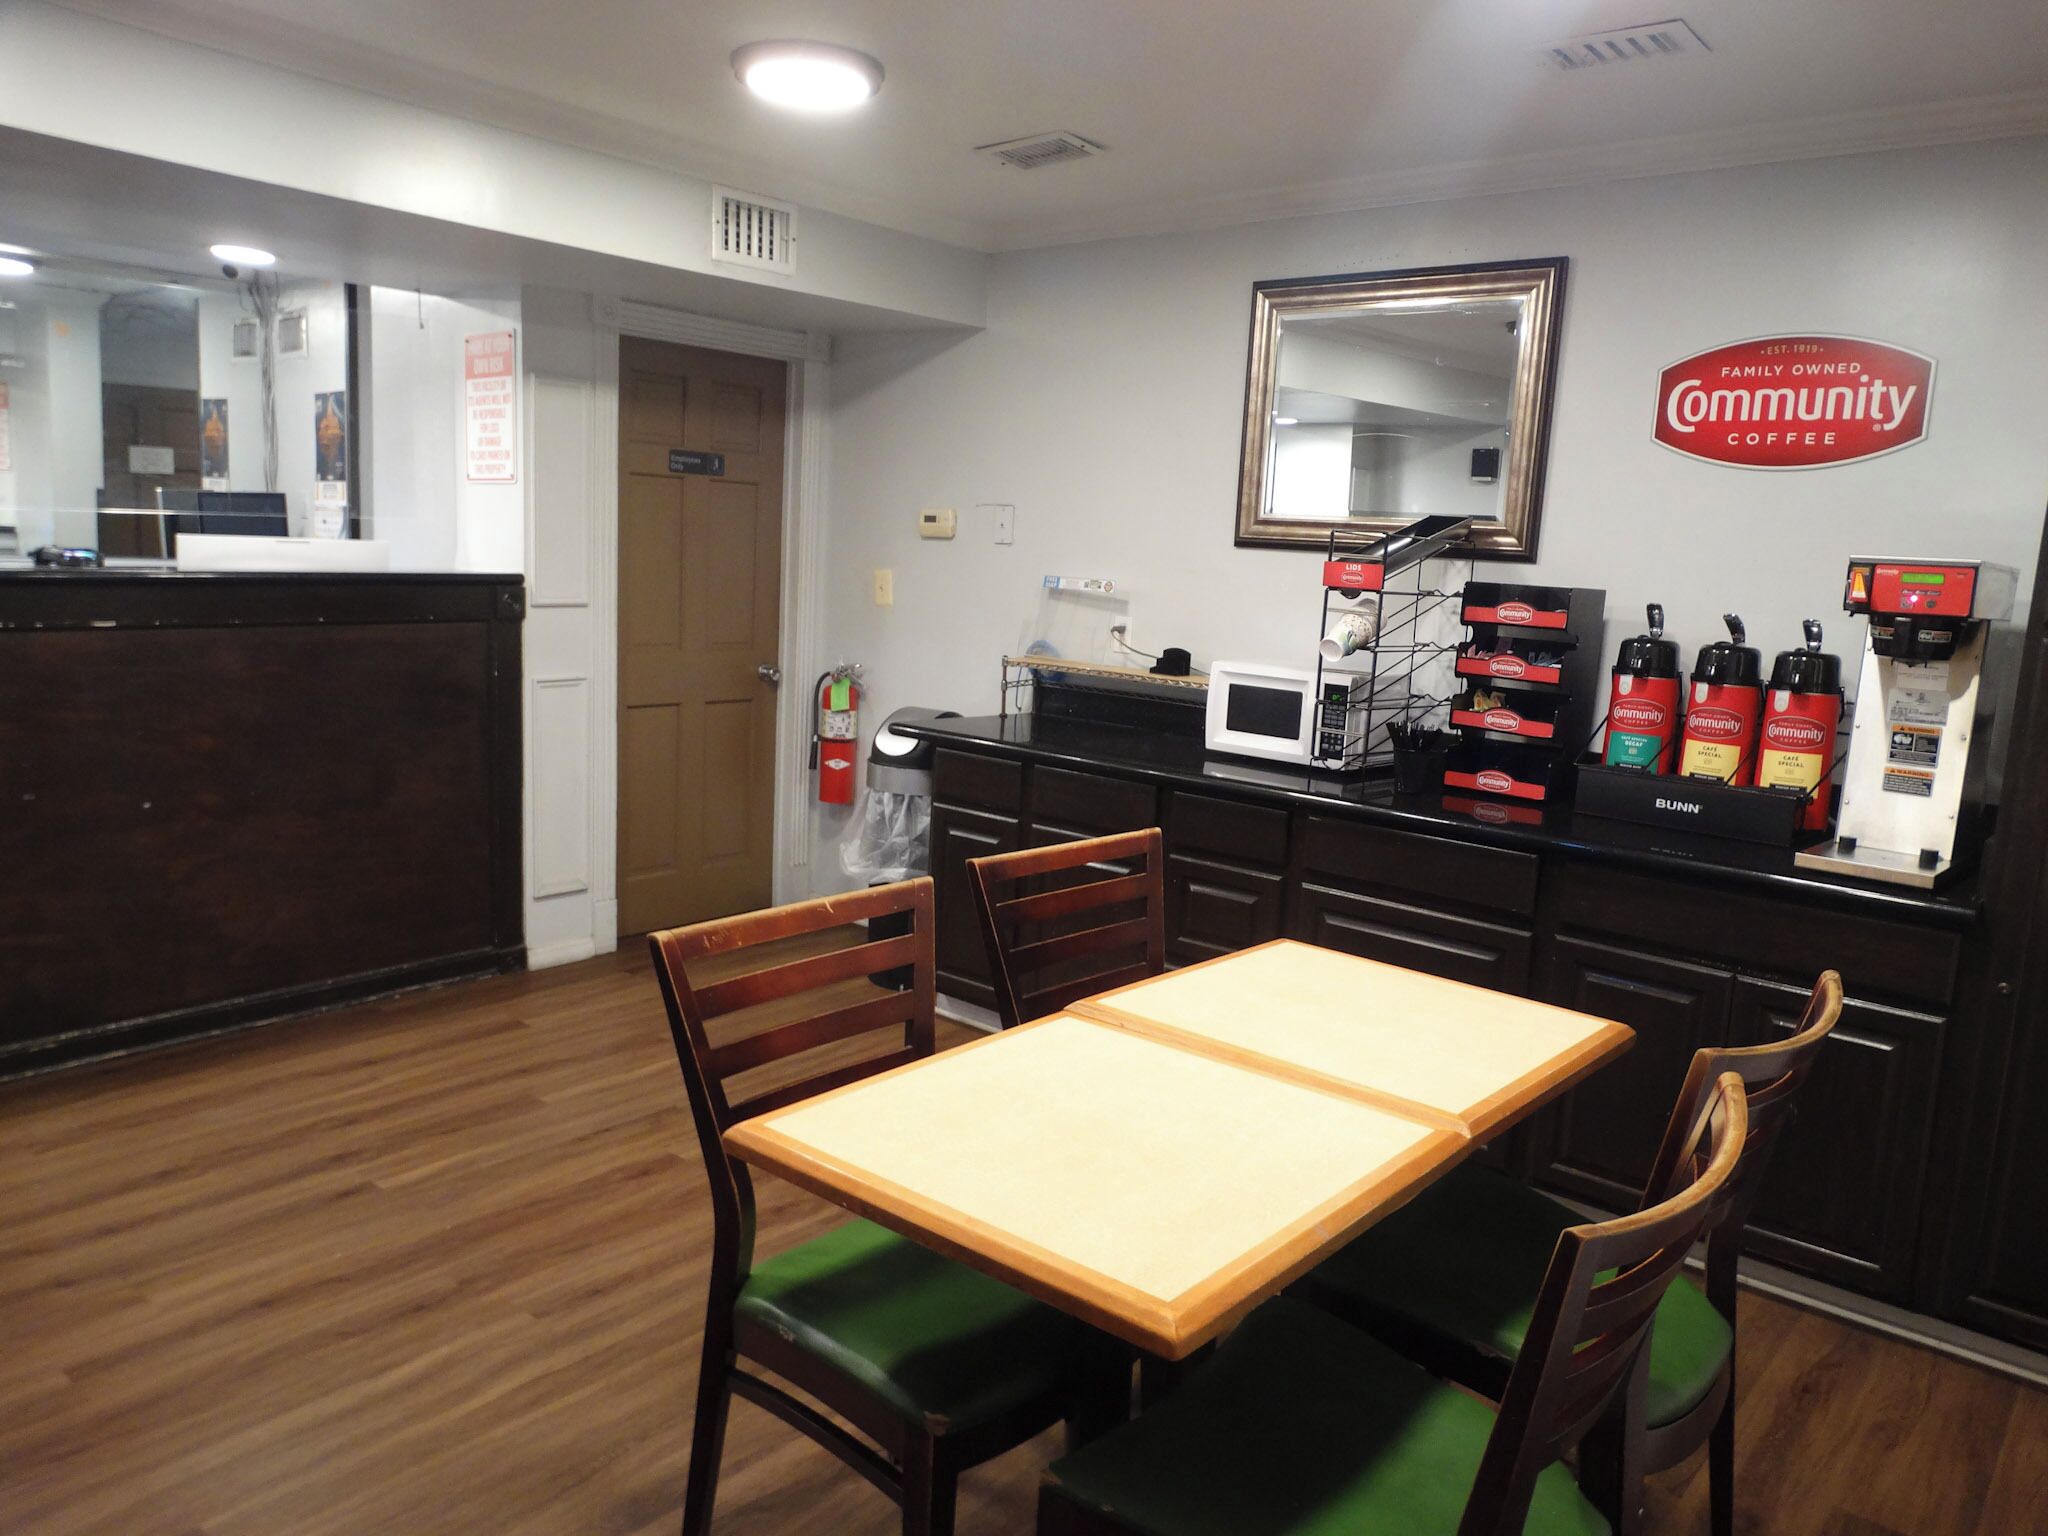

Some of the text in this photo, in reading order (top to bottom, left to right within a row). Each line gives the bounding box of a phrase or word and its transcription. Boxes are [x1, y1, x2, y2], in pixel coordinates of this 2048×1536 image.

[1721, 362, 1861, 378] FAMILY OWNED
[1667, 374, 1917, 433] Community
[1727, 432, 1836, 446] COFFEE
[1345, 563, 1362, 571] LIDS
[1613, 705, 1664, 724] Community
[1689, 714, 1741, 733] Community
[1768, 723, 1824, 742] Community
[1655, 798, 1699, 814] BUNN
